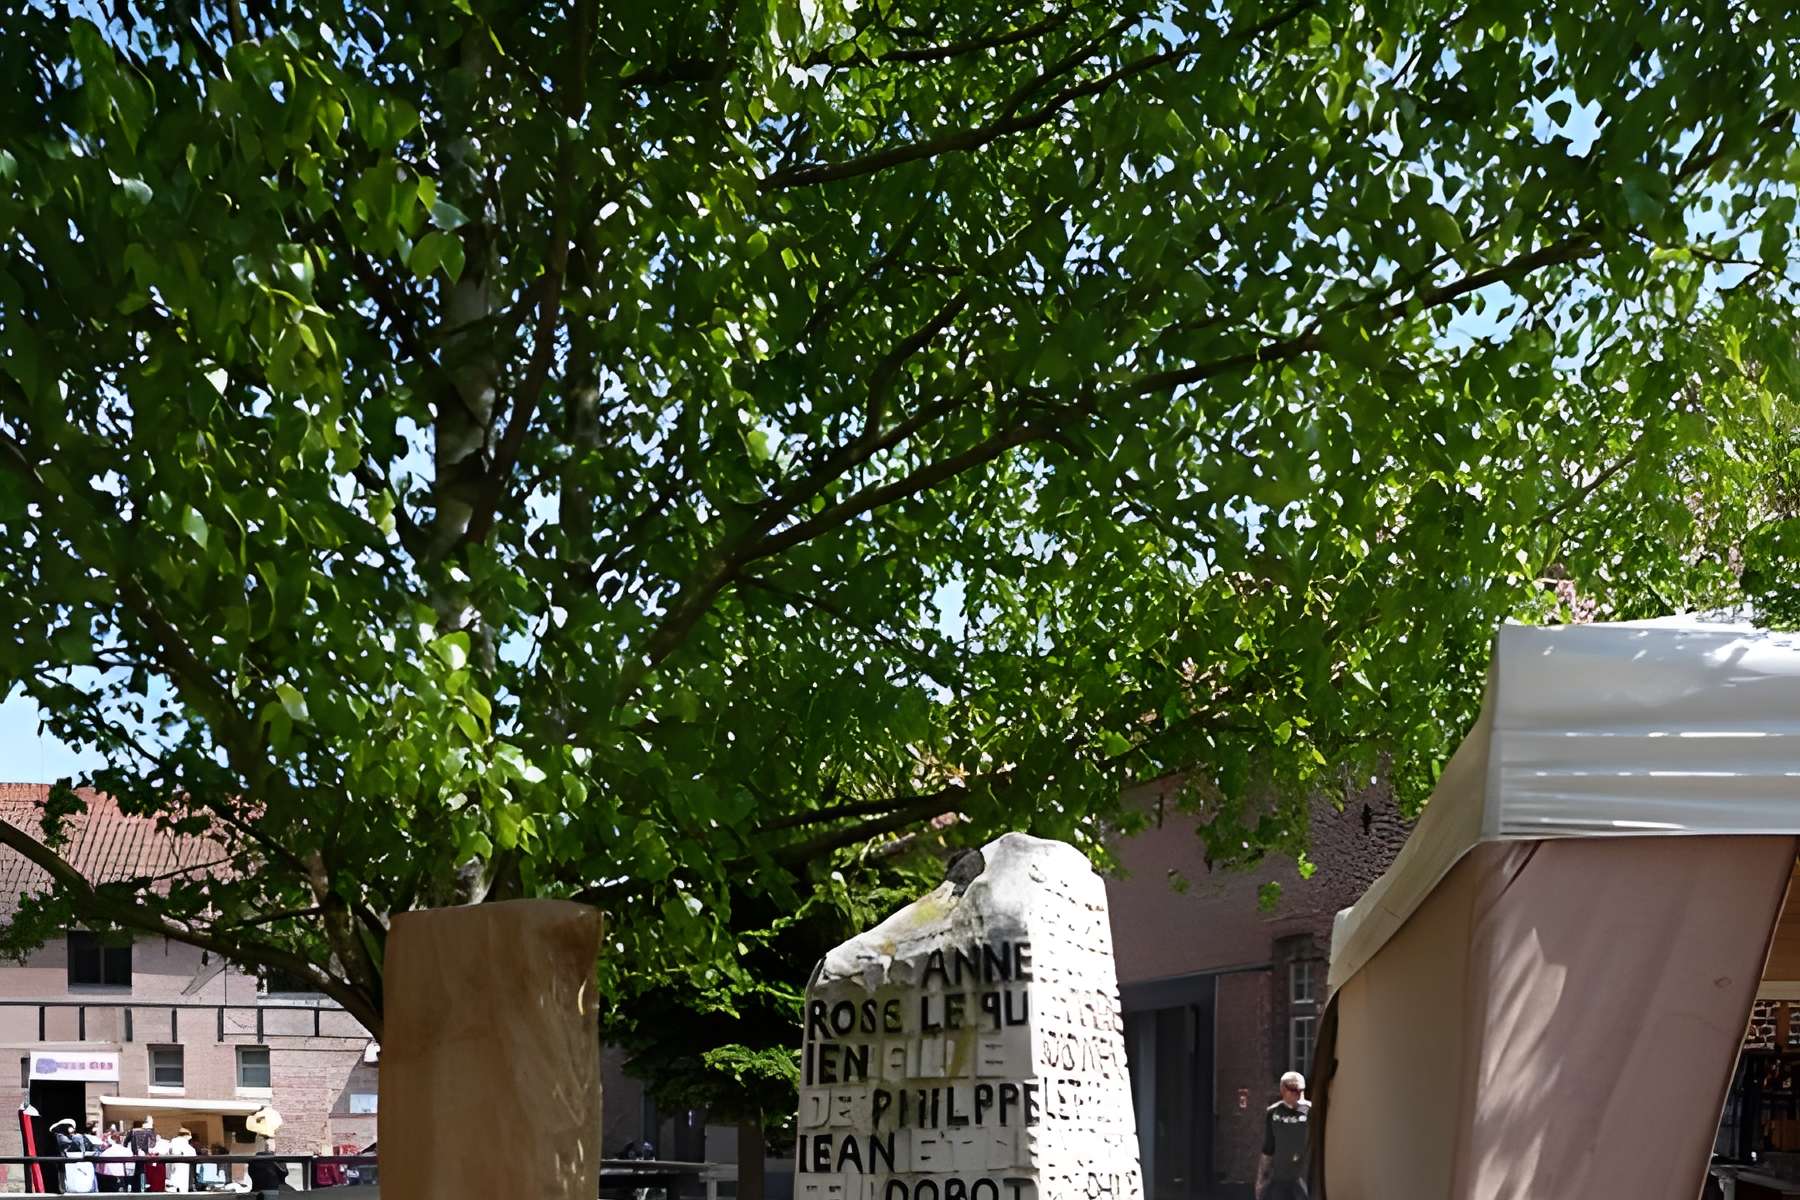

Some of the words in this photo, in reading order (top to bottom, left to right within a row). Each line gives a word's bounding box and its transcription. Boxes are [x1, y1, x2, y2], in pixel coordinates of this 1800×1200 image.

[920, 941, 1033, 988] ANNE
[807, 998, 903, 1041] ROSE
[806, 1044, 869, 1086] IEN
